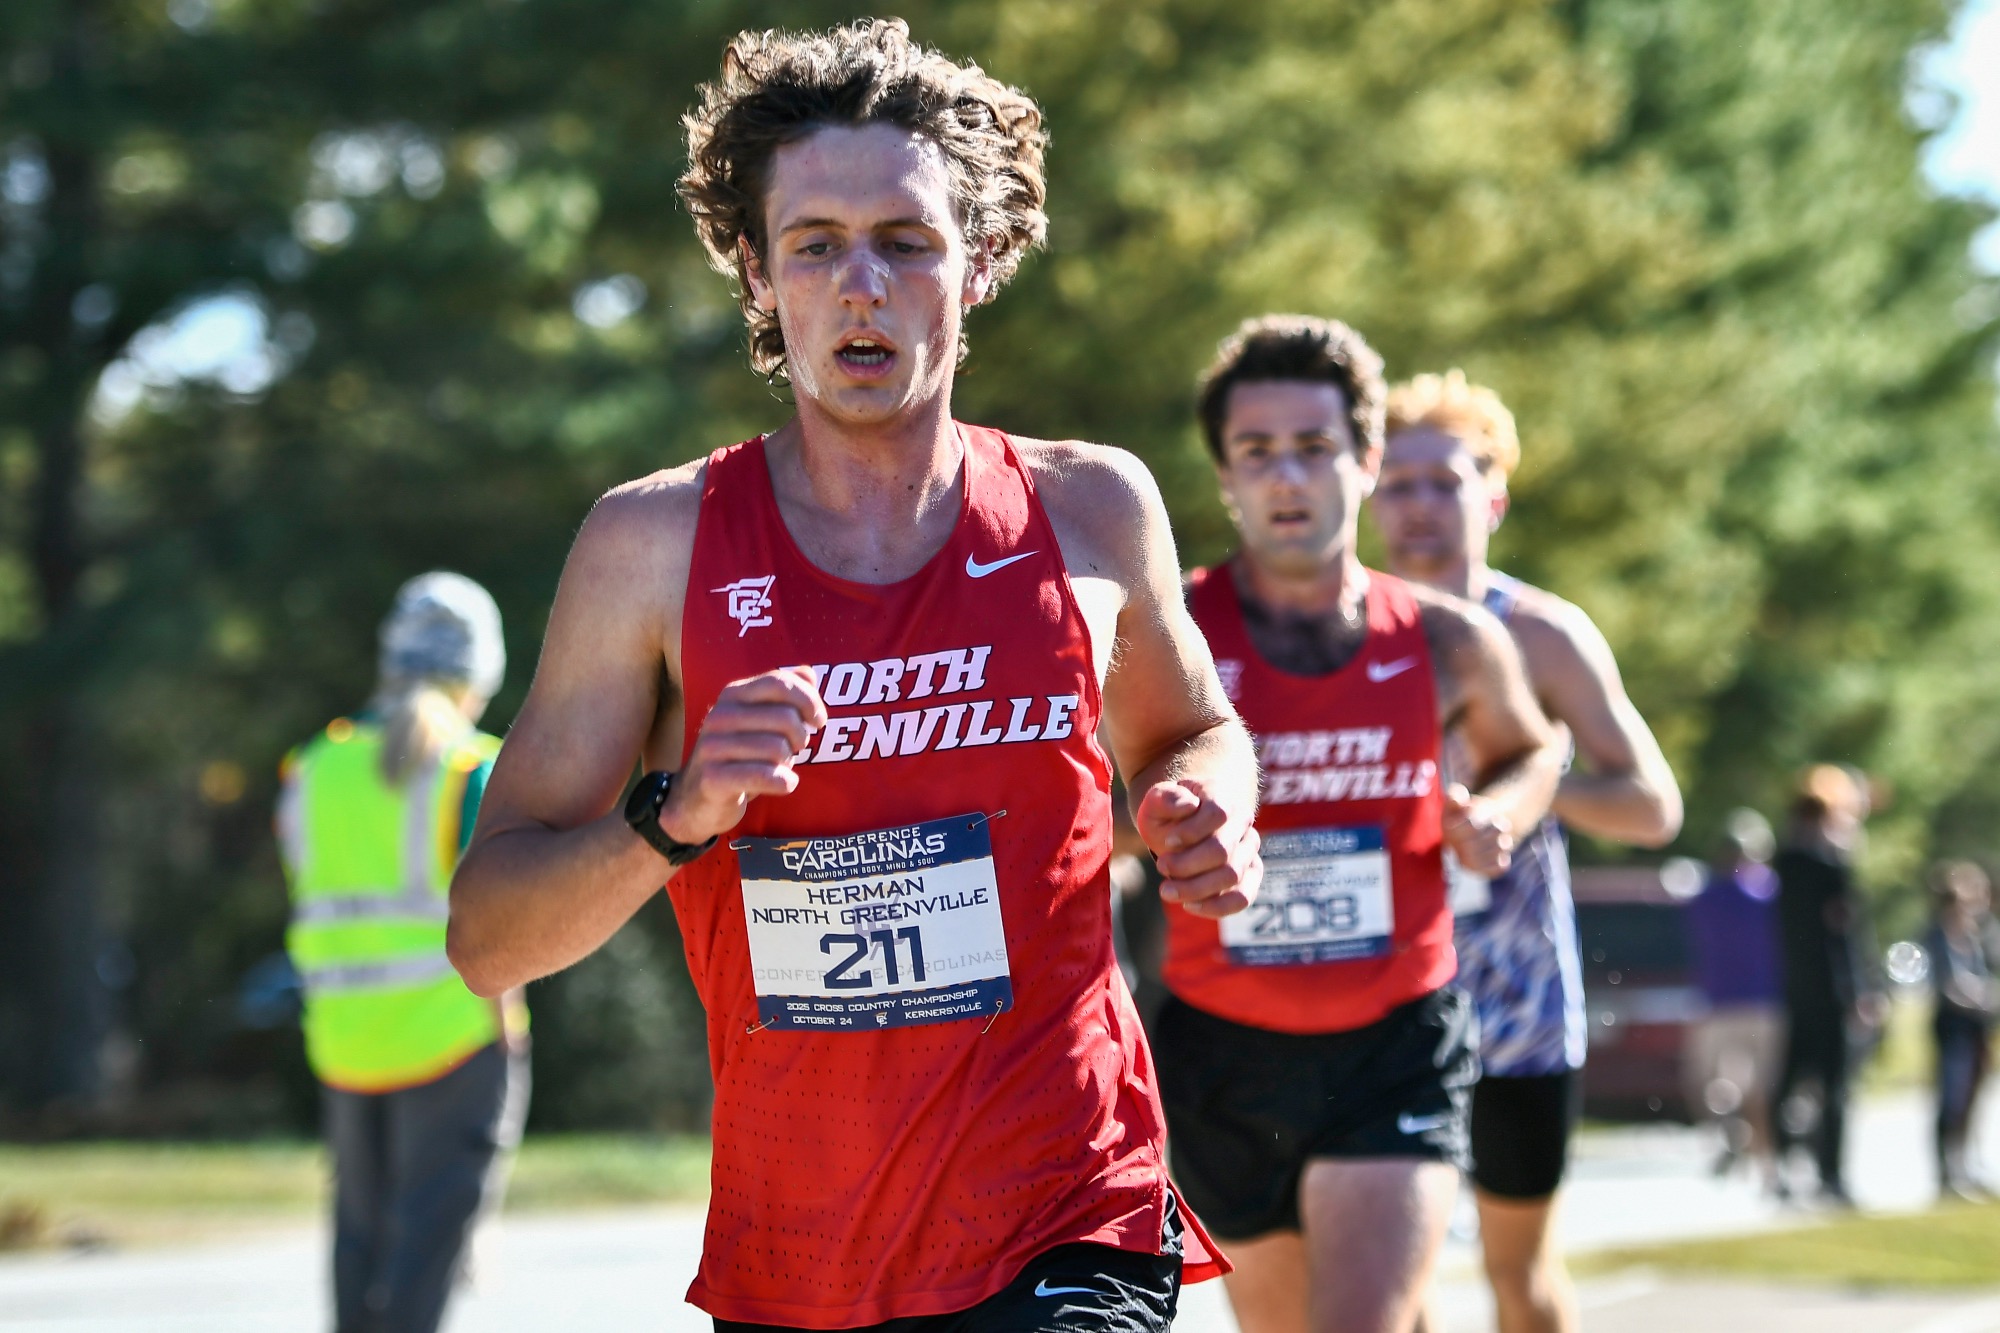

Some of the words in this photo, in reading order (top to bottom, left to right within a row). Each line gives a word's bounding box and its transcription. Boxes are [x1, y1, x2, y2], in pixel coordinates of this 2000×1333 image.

[794, 695, 1080, 765] ENVILLE
[782, 833, 946, 874] CAROLINAS
[814, 827, 921, 851] CONFERENCE
[804, 868, 847, 880] CHAMPIONS
[850, 867, 859, 876] IN
[886, 863, 906, 872] MIND
[917, 857, 935, 866] SOUL
[752, 908, 831, 925] NORTH
[840, 888, 989, 925] GREENVILLE
[806, 876, 925, 906] HERMAN
[1249, 893, 1360, 937] 208
[820, 926, 926, 989] 211
[786, 1002, 810, 1011] 2025
[813, 1003, 844, 1012] CROSS
[848, 999, 897, 1012] COUNTRY
[901, 988, 978, 1007] CHAMPIONSHIP
[792, 1015, 836, 1026] OCTOBER
[839, 1017, 853, 1026] 24
[904, 1001, 982, 1020] KERNERSVILLE
